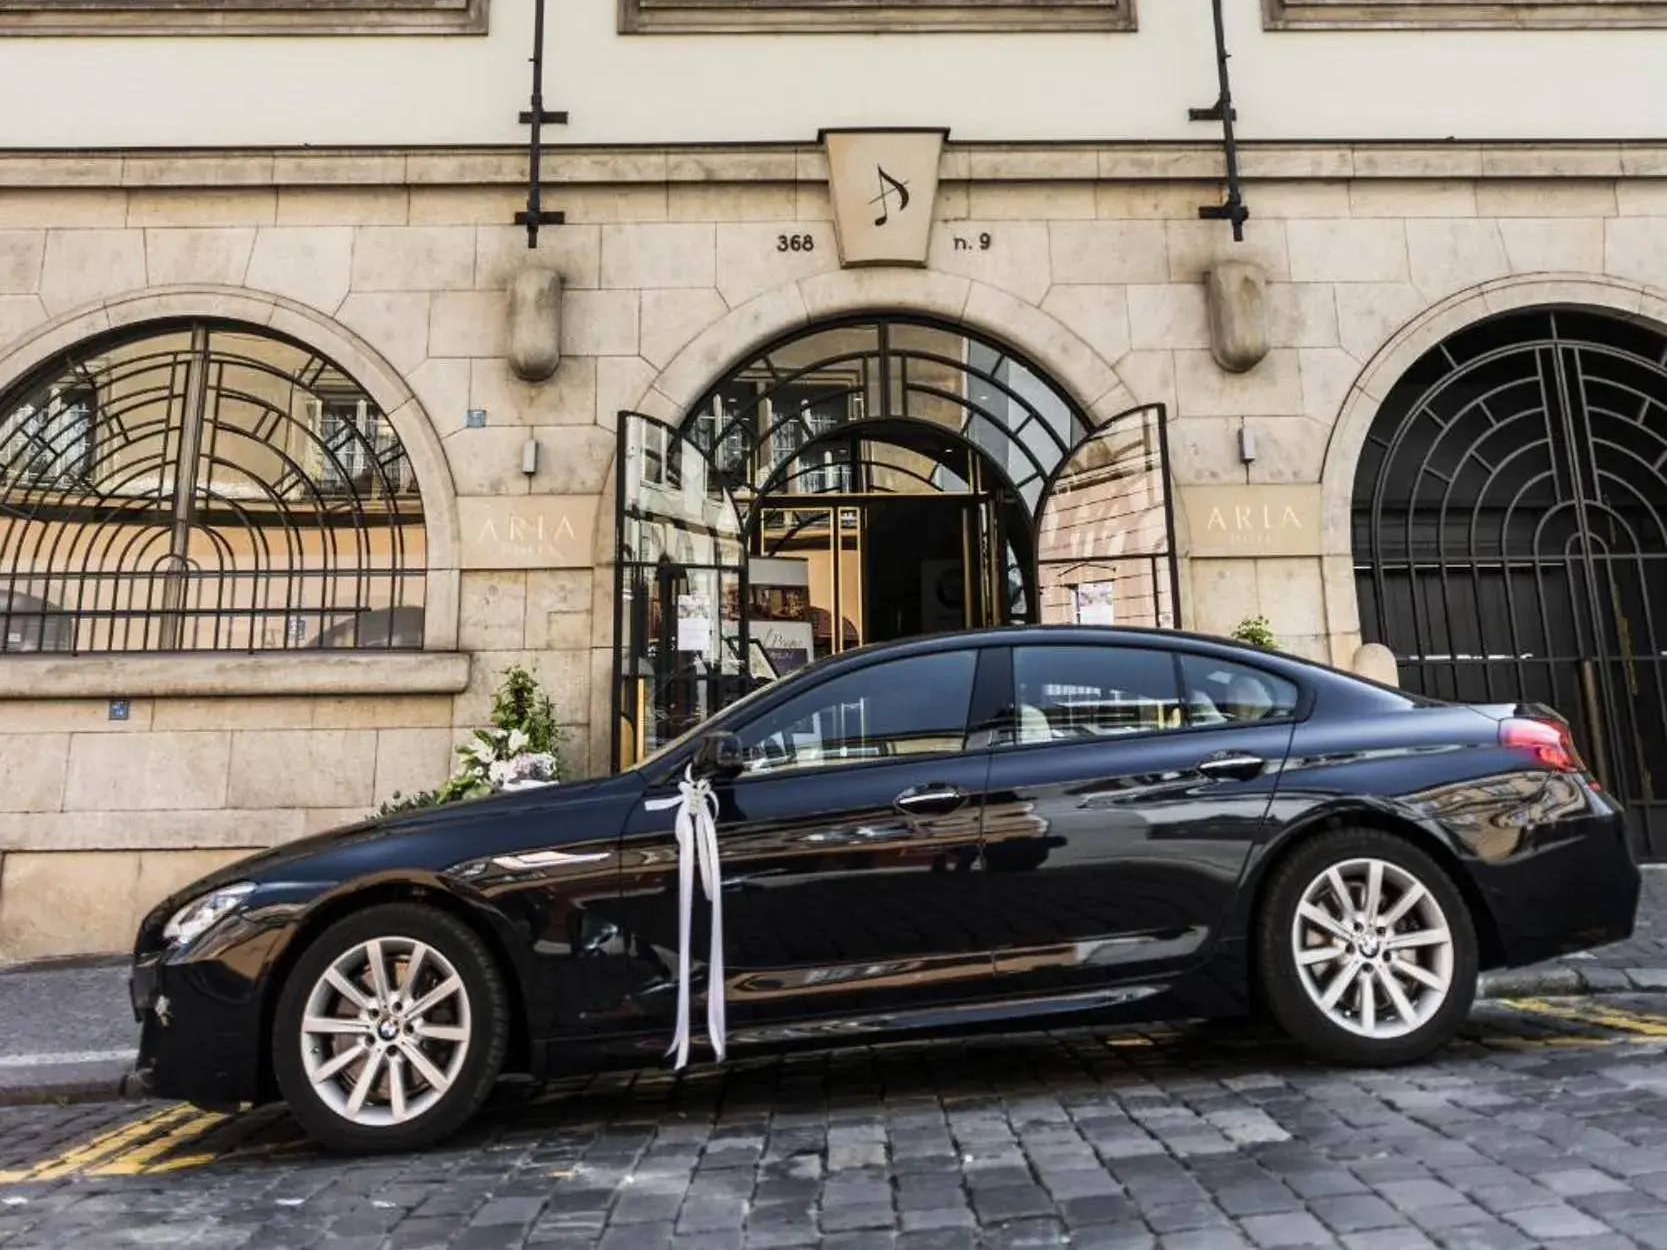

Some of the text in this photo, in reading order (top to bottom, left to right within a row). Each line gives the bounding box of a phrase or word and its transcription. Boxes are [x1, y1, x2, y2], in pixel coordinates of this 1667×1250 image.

[776, 234, 815, 252] 368
[479, 514, 577, 542] ARIA
[1206, 504, 1303, 531] ARIA
